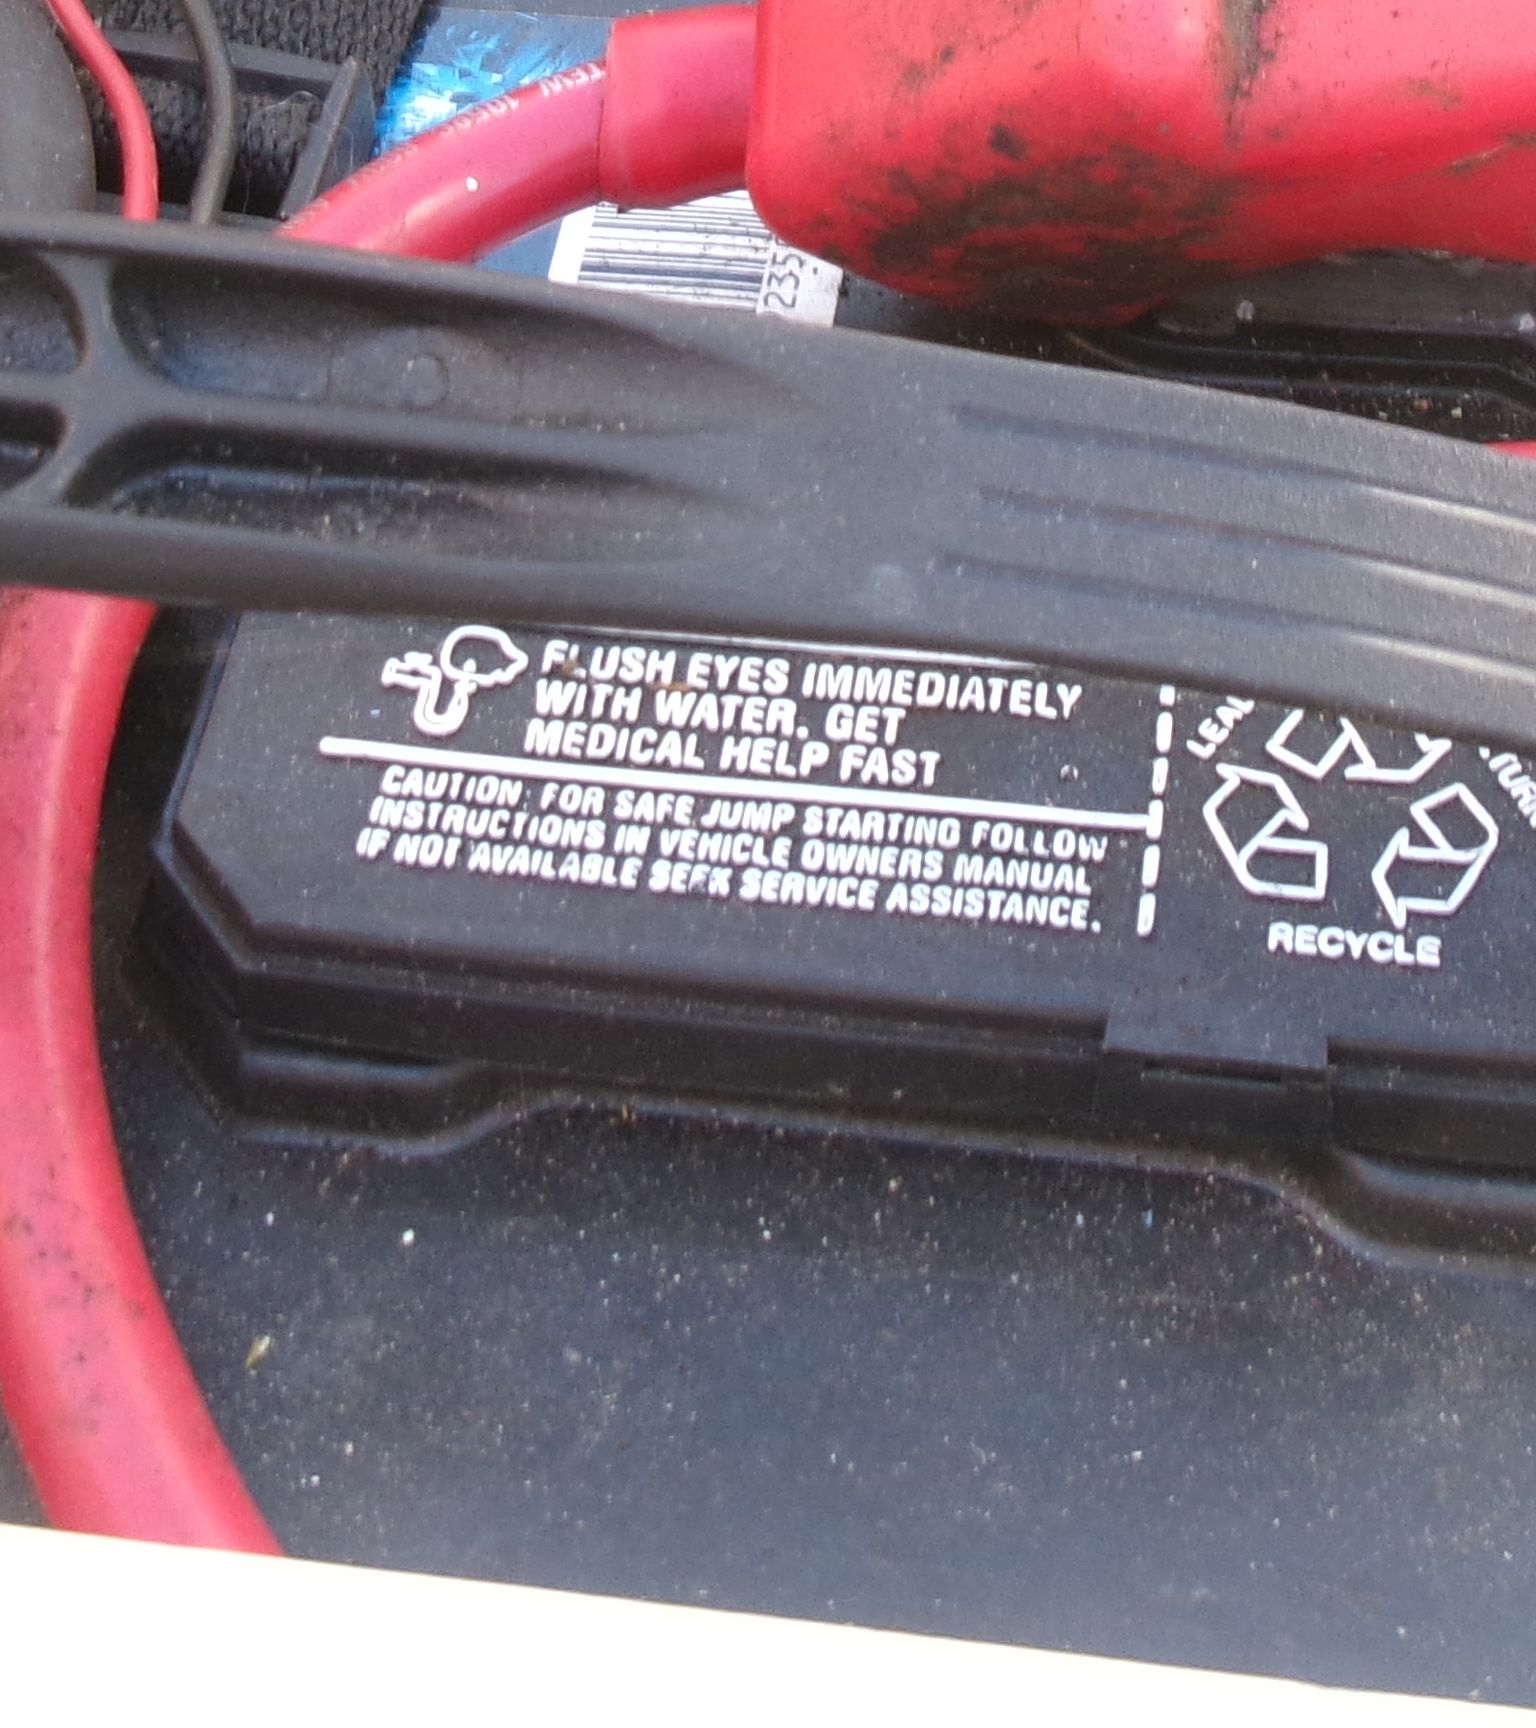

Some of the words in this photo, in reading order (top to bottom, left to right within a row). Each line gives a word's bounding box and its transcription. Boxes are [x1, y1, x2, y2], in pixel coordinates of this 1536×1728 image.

[763, 236, 805, 308] 235
[535, 678, 642, 723] WITH
[654, 689, 810, 740] WATER.
[825, 703, 907, 747] GET
[541, 639, 676, 684] FLUSH
[686, 653, 791, 696] EYES
[801, 662, 1084, 721] IMMEDIATELY
[523, 718, 706, 770] MEDICAL
[718, 734, 831, 779] HELP
[838, 743, 942, 788] FAST
[368, 795, 606, 850] INSTRUCTIONS
[614, 823, 651, 855] IN
[659, 827, 792, 870] VEHICLE
[800, 838, 944, 881] OWNERS
[953, 854, 1092, 896] MANUAL
[540, 782, 606, 816] FOR
[613, 789, 695, 825] SAFE
[701, 798, 796, 833] JUMP
[802, 805, 961, 850] STARTING
[971, 820, 1109, 863] FOLLOW
[355, 827, 392, 859] IF
[393, 834, 461, 869] NOT
[467, 840, 643, 889] AVAILABLE
[649, 860, 731, 898] SEEK
[739, 868, 880, 912] SERVICE
[885, 882, 1102, 933] ASSISTANCE.
[1267, 920, 1443, 968] RECYCLE
